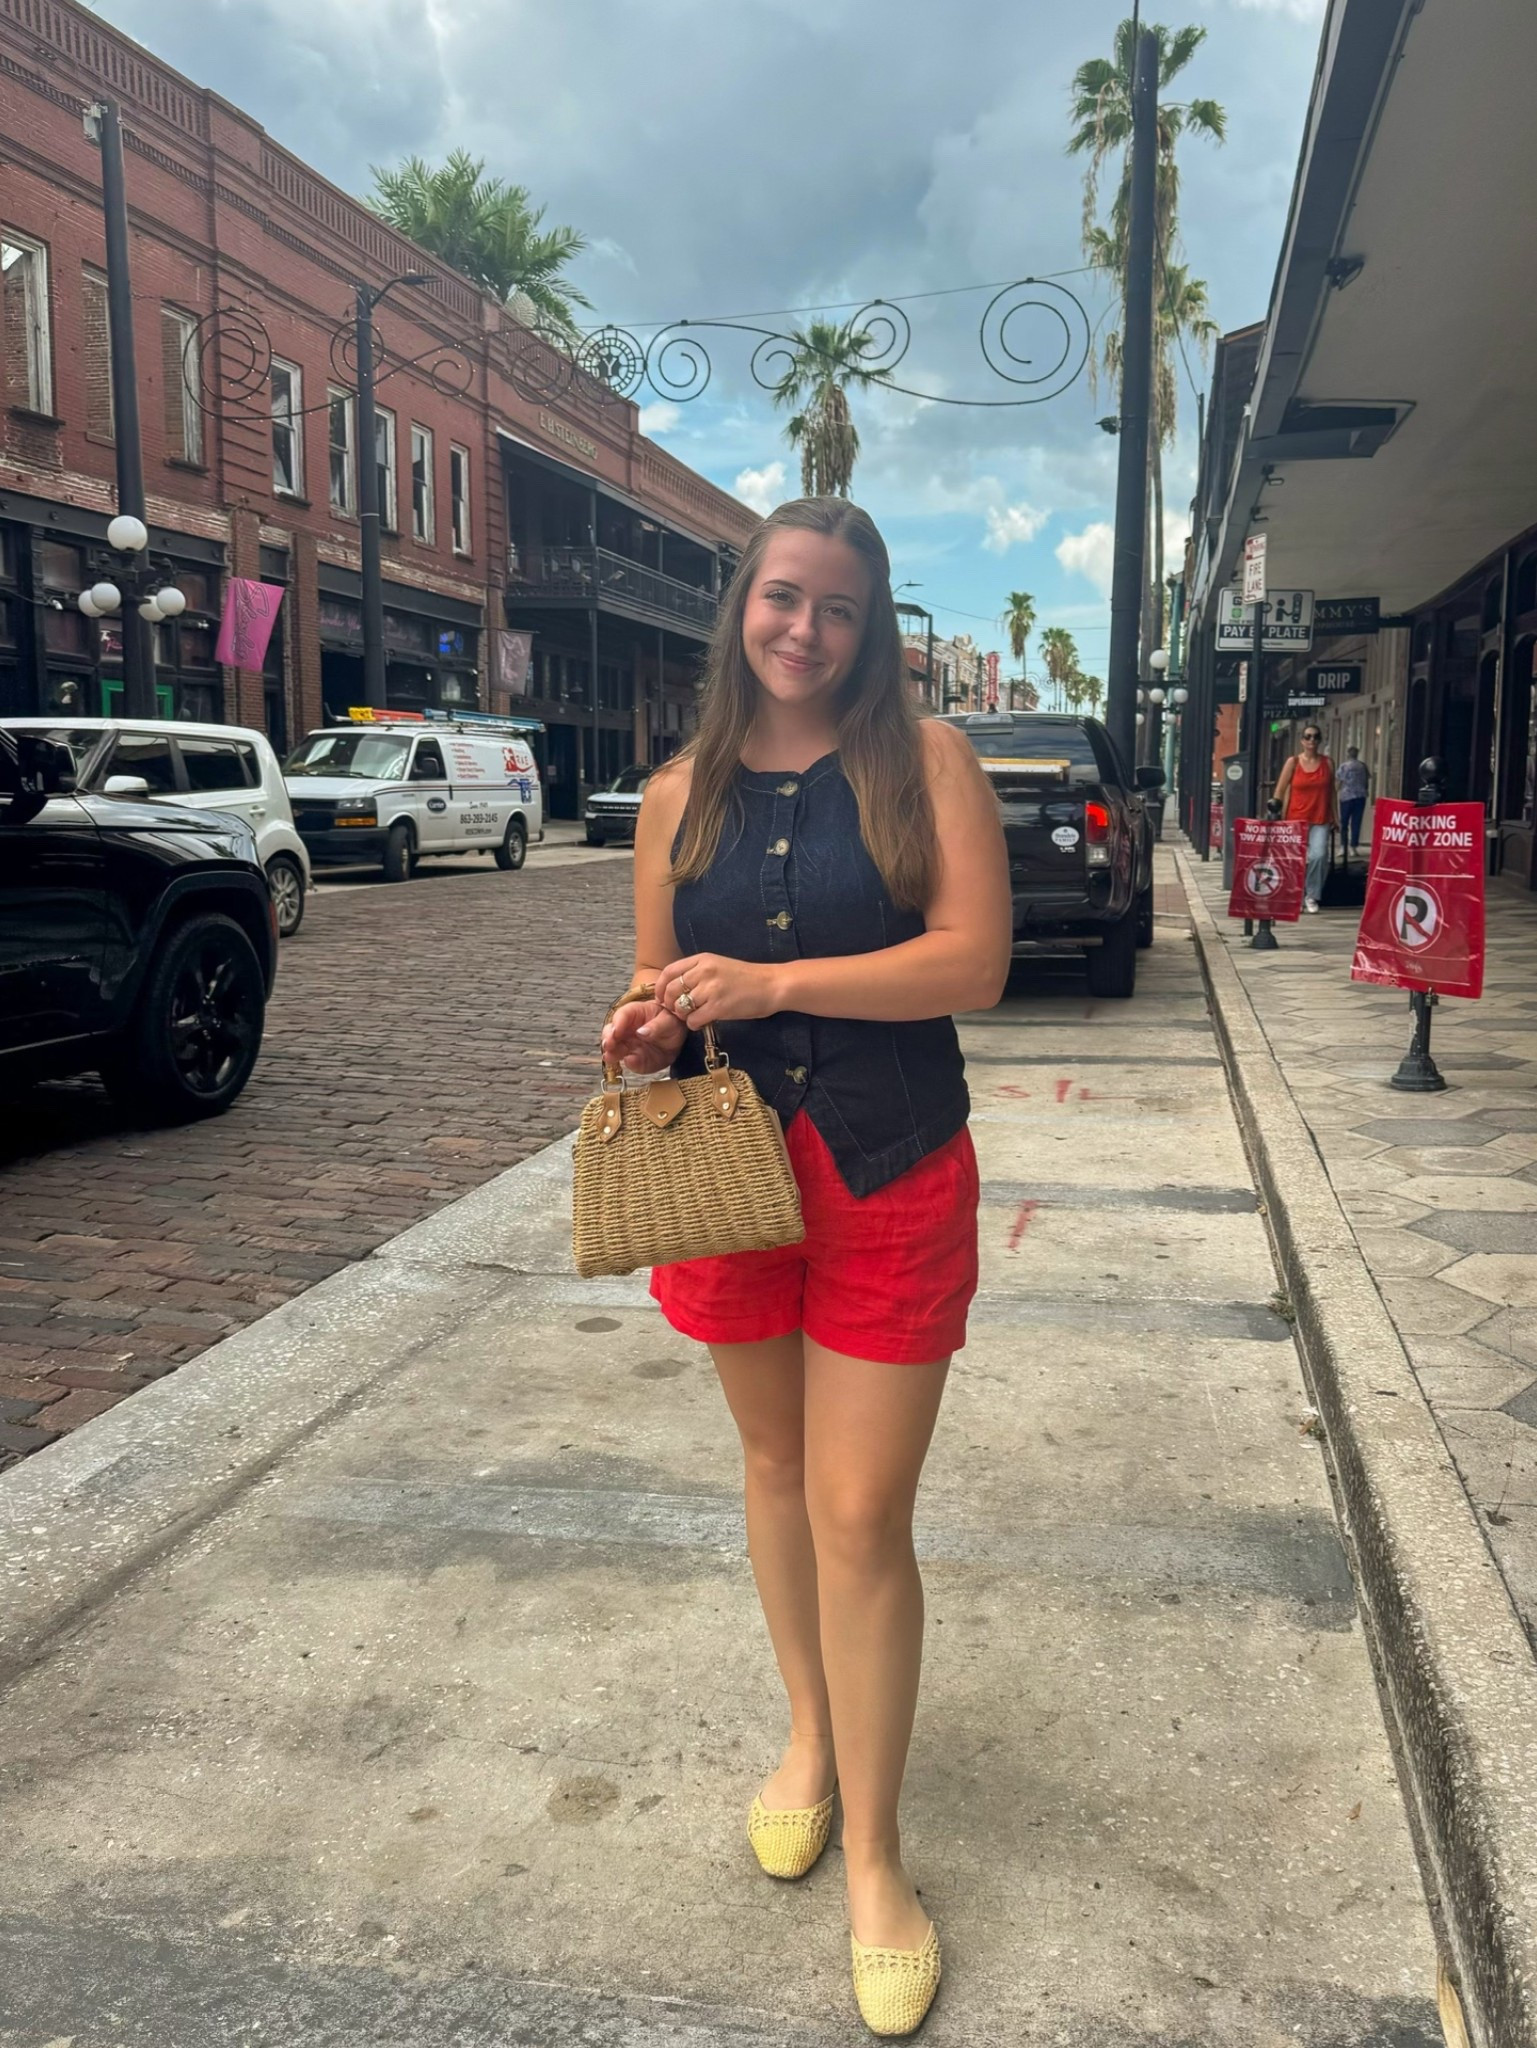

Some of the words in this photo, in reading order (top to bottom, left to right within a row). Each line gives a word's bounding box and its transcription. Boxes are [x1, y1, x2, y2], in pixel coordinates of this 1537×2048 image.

[1249, 562, 1262, 576] FIRE
[1248, 579, 1262, 593] LANE
[1223, 626, 1245, 637] PAY
[1269, 627, 1307, 638] PLATE
[1317, 673, 1350, 689] DRIP
[1277, 835, 1302, 844] ZONE
[1433, 832, 1473, 847] ZONE
